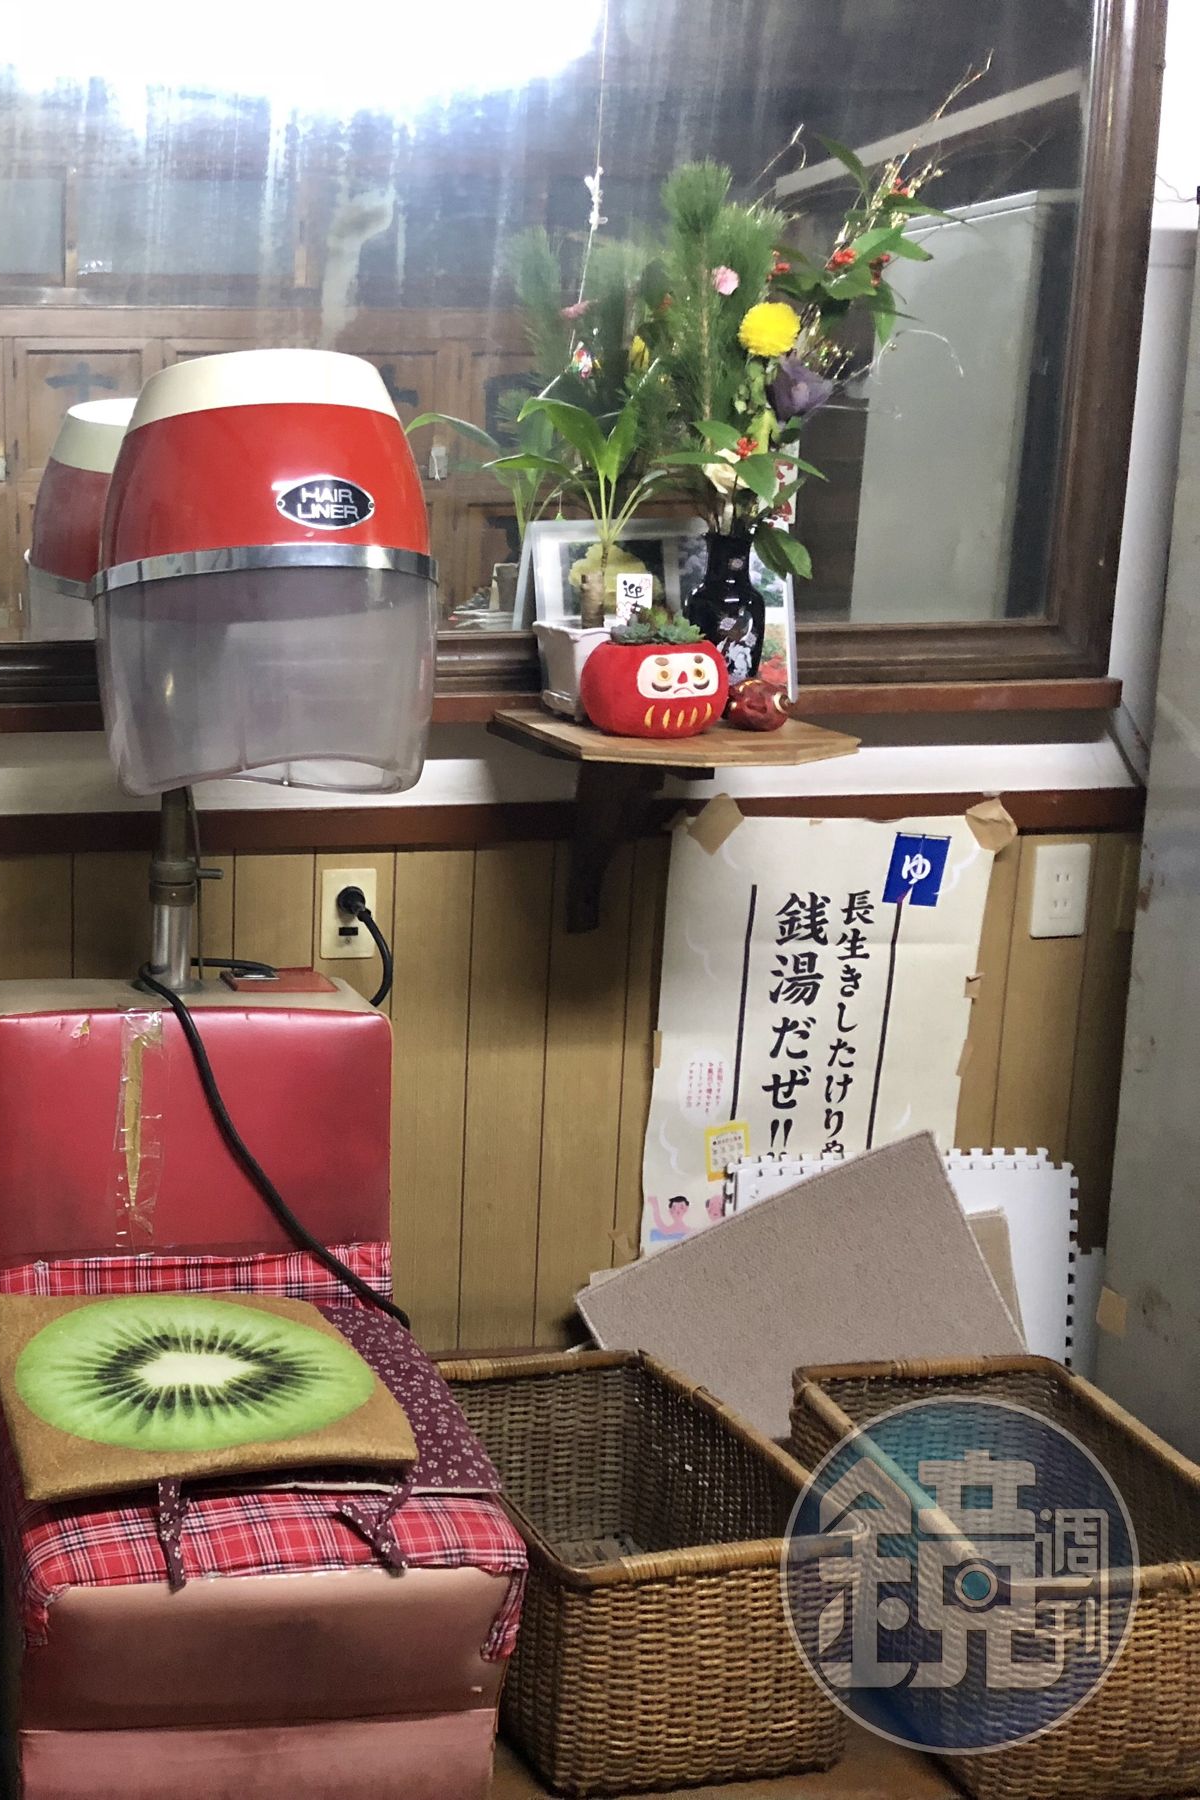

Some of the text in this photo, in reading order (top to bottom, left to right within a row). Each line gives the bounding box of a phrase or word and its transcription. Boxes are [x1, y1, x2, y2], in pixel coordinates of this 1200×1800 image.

[301, 487, 354, 504] HAIR
[297, 503, 360, 519] LINER
[902, 853, 931, 885] ゆ
